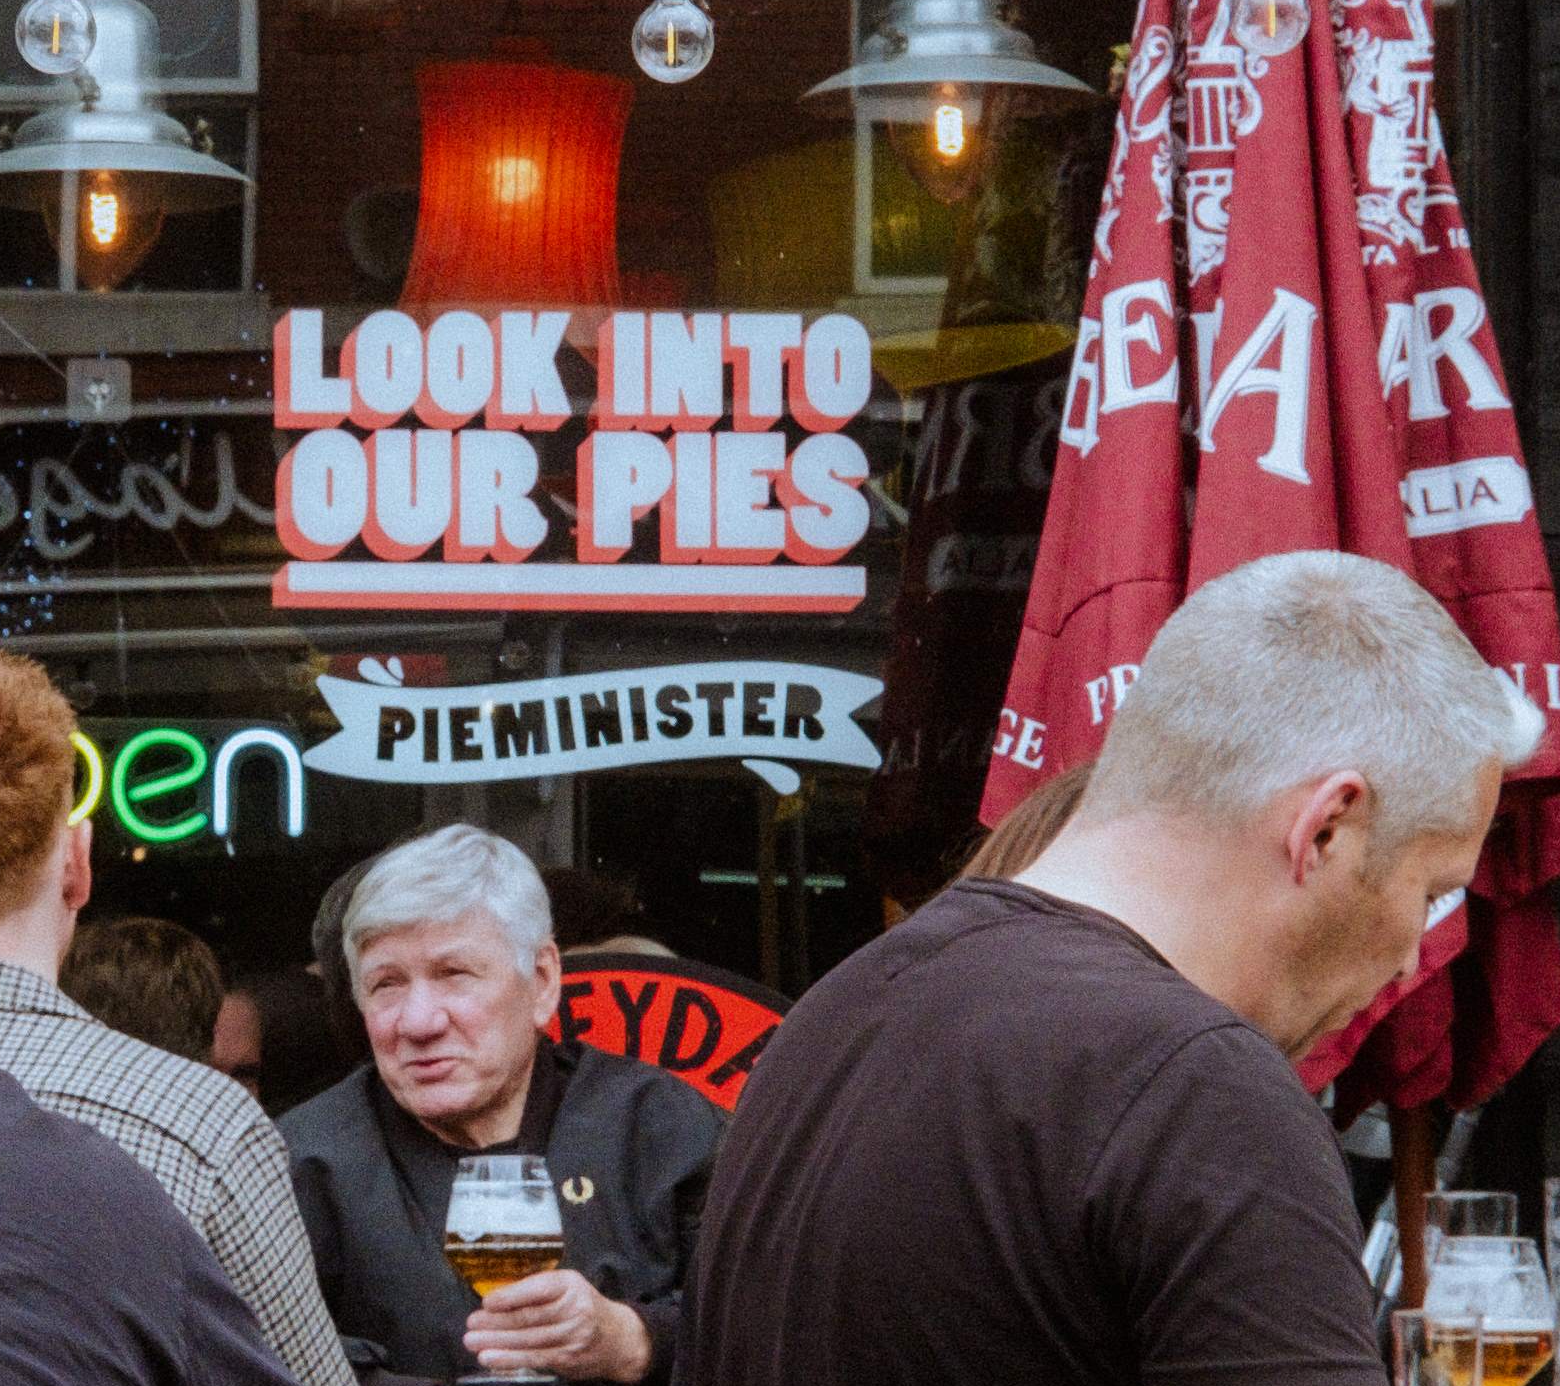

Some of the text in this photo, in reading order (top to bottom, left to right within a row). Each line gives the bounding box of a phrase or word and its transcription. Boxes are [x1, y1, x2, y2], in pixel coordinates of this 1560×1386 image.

[274, 308, 872, 435] LOOK INTO
[274, 429, 548, 561] OUR
[577, 431, 872, 564] PIES
[375, 680, 825, 764] PIEMINISTER
